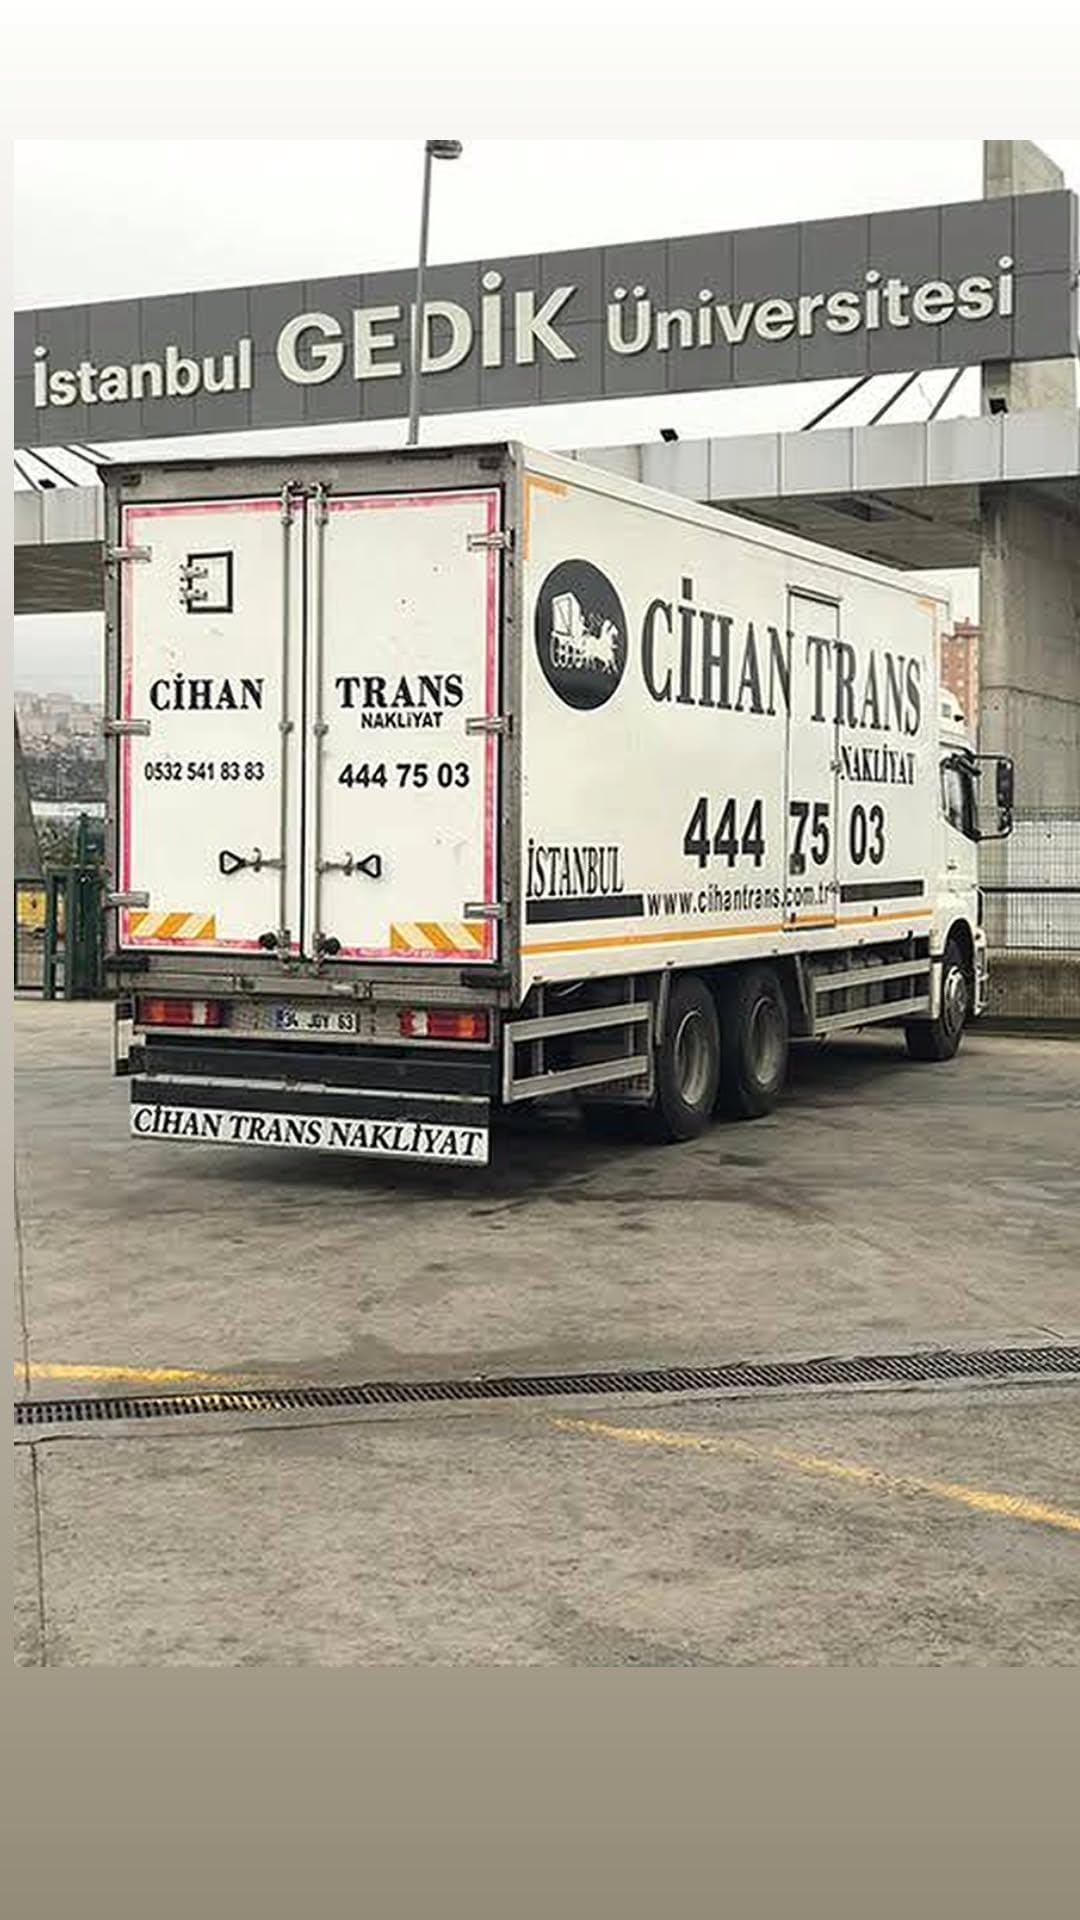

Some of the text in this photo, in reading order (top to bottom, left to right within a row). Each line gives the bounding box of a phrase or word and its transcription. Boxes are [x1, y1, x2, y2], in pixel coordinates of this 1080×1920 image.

[276, 271, 577, 385] GEDİK
[607, 254, 1015, 355] Üniversitesi
[640, 576, 922, 738] CİHAN TRANS
[150, 672, 464, 711] CİHAN TRANS
[144, 761, 265, 781] 0532 541 83 83
[338, 763, 470, 788] 444 75 03
[840, 743, 915, 785] NAKLİYAT
[683, 797, 886, 876] 444 75 03
[526, 838, 625, 898] İSTANBUL
[646, 883, 830, 917] www.cihantrans.com.tr
[133, 1104, 484, 1156] CİHAN TRANS NAKLİYAT
